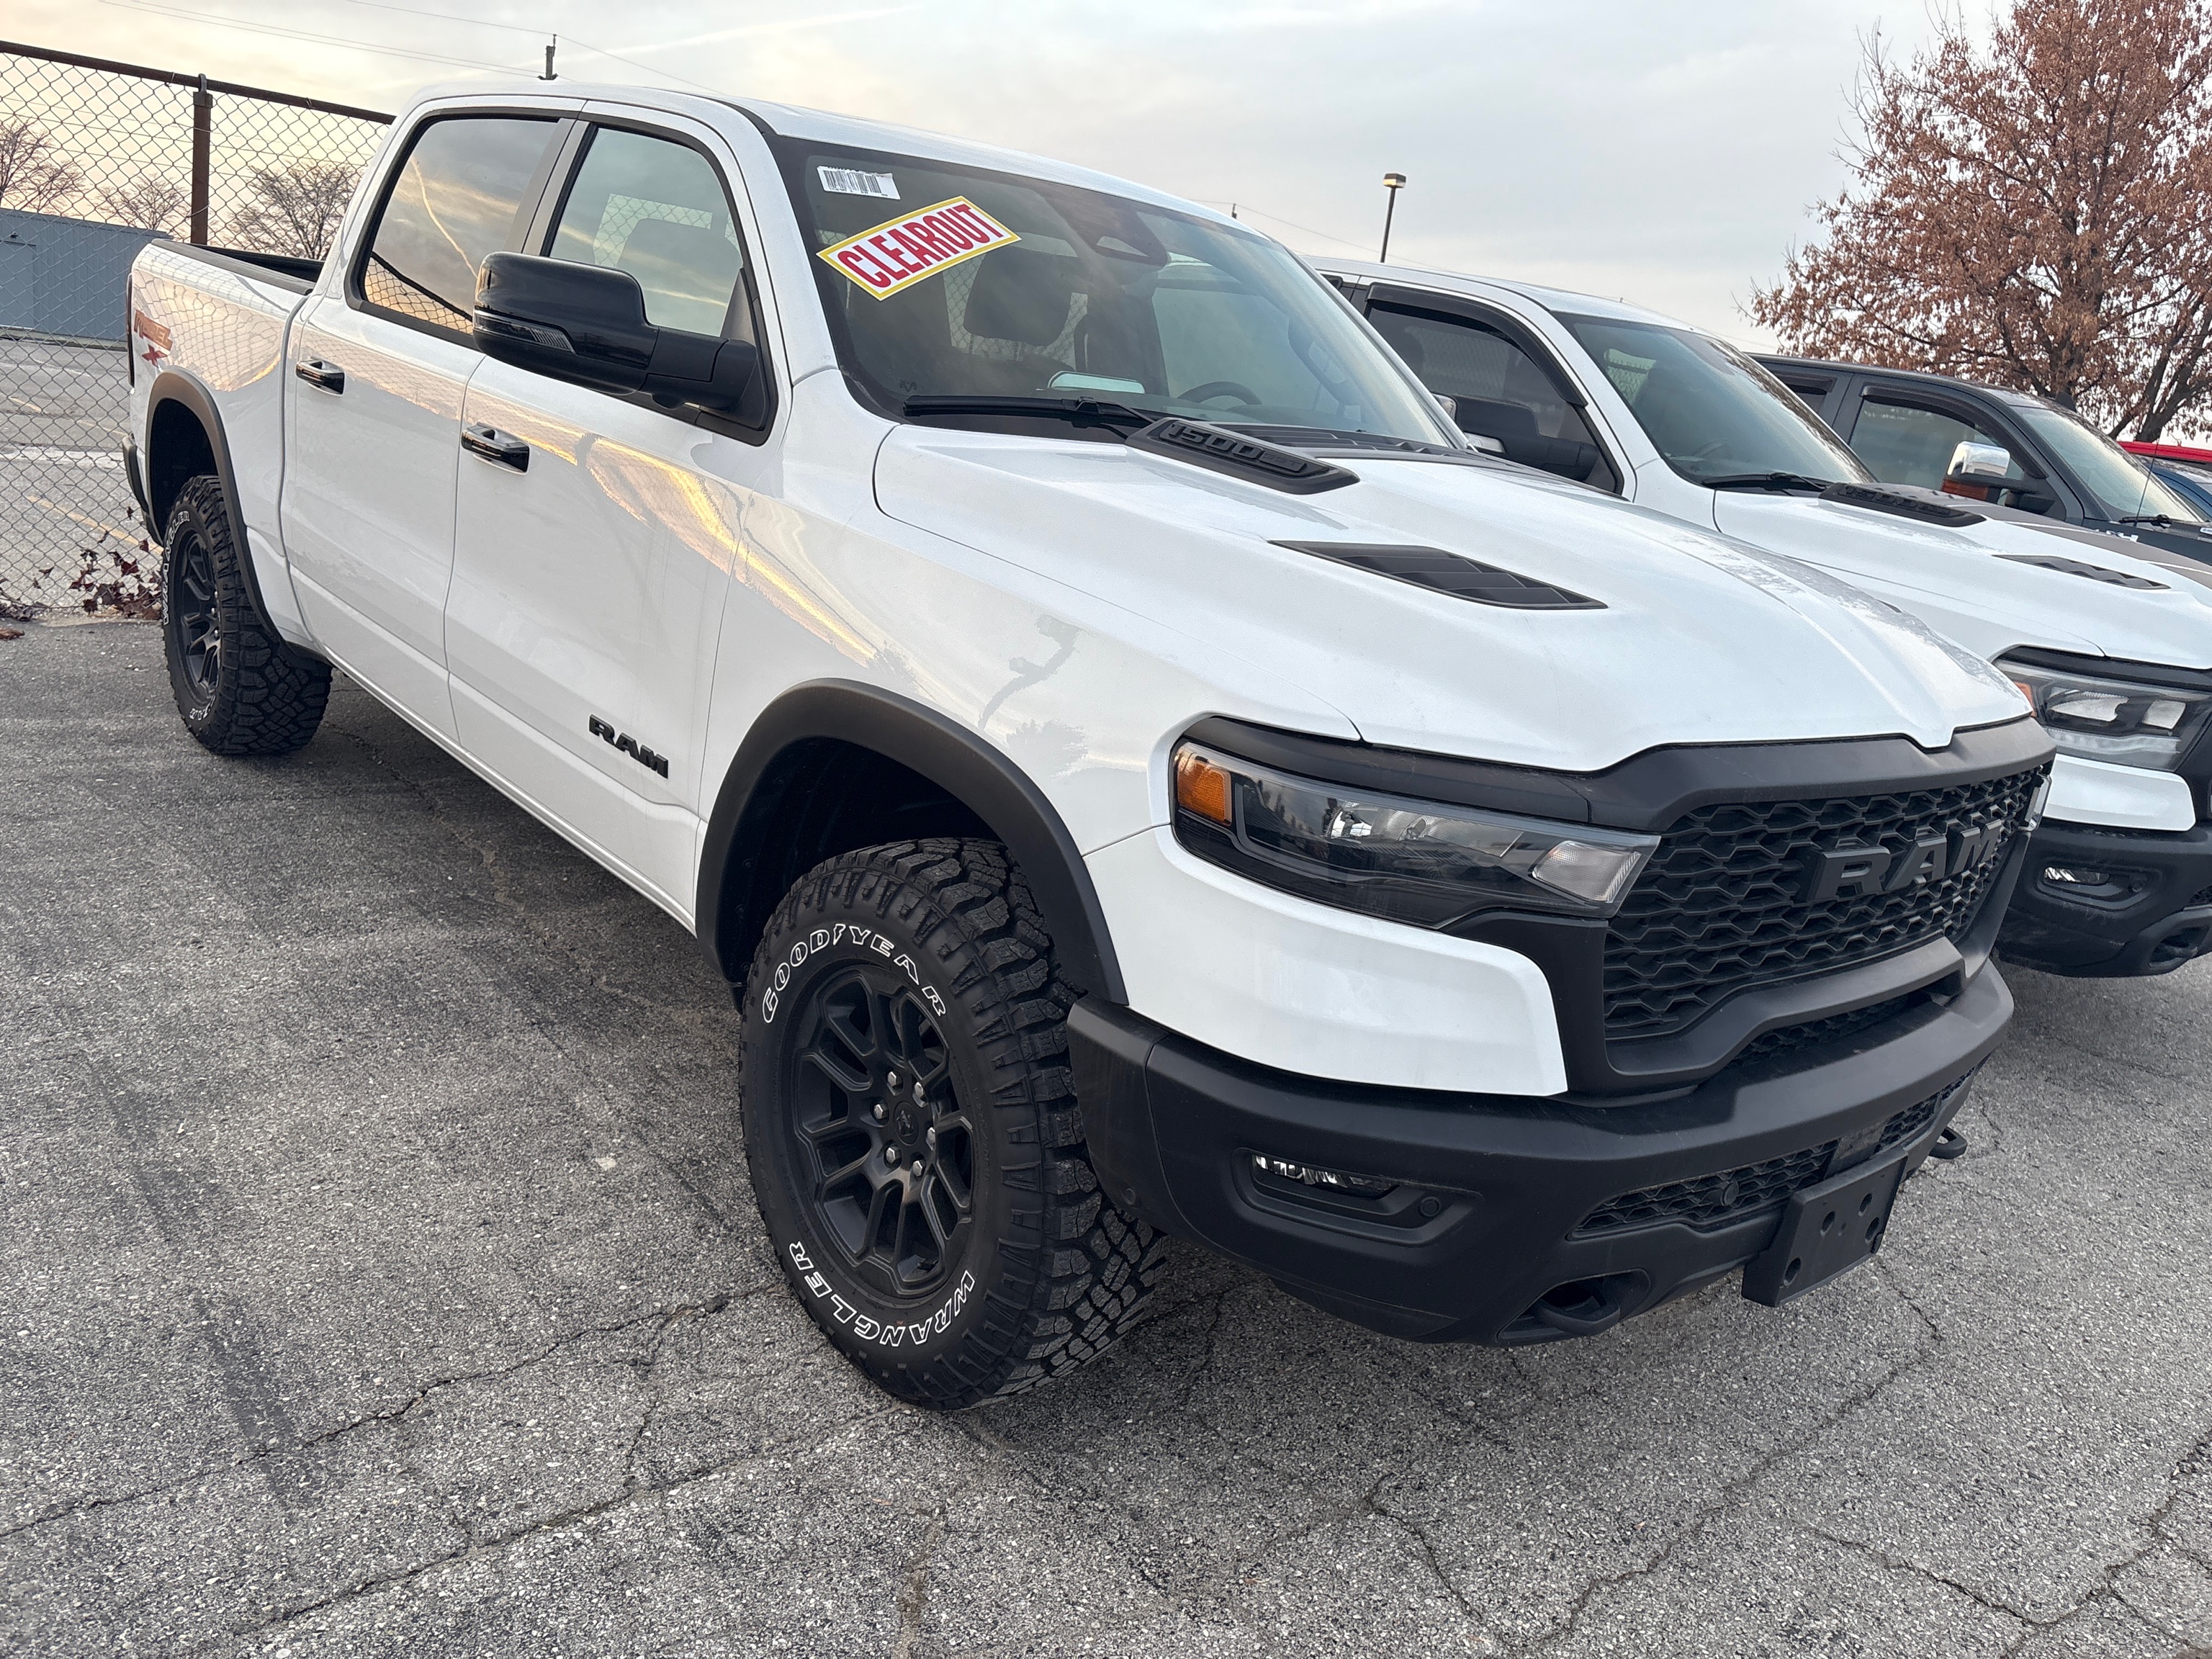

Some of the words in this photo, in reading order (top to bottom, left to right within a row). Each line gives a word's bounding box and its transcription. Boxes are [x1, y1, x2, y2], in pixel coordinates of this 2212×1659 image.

[837, 203, 1004, 288] CLEAROUT
[1167, 422, 1264, 459] 1500
[161, 510, 191, 625] WRANGLER
[589, 714, 669, 780] RAM
[1808, 819, 2002, 902] RAM
[763, 923, 947, 1024] GOODYEAR
[788, 1240, 976, 1347] WRANGLER
